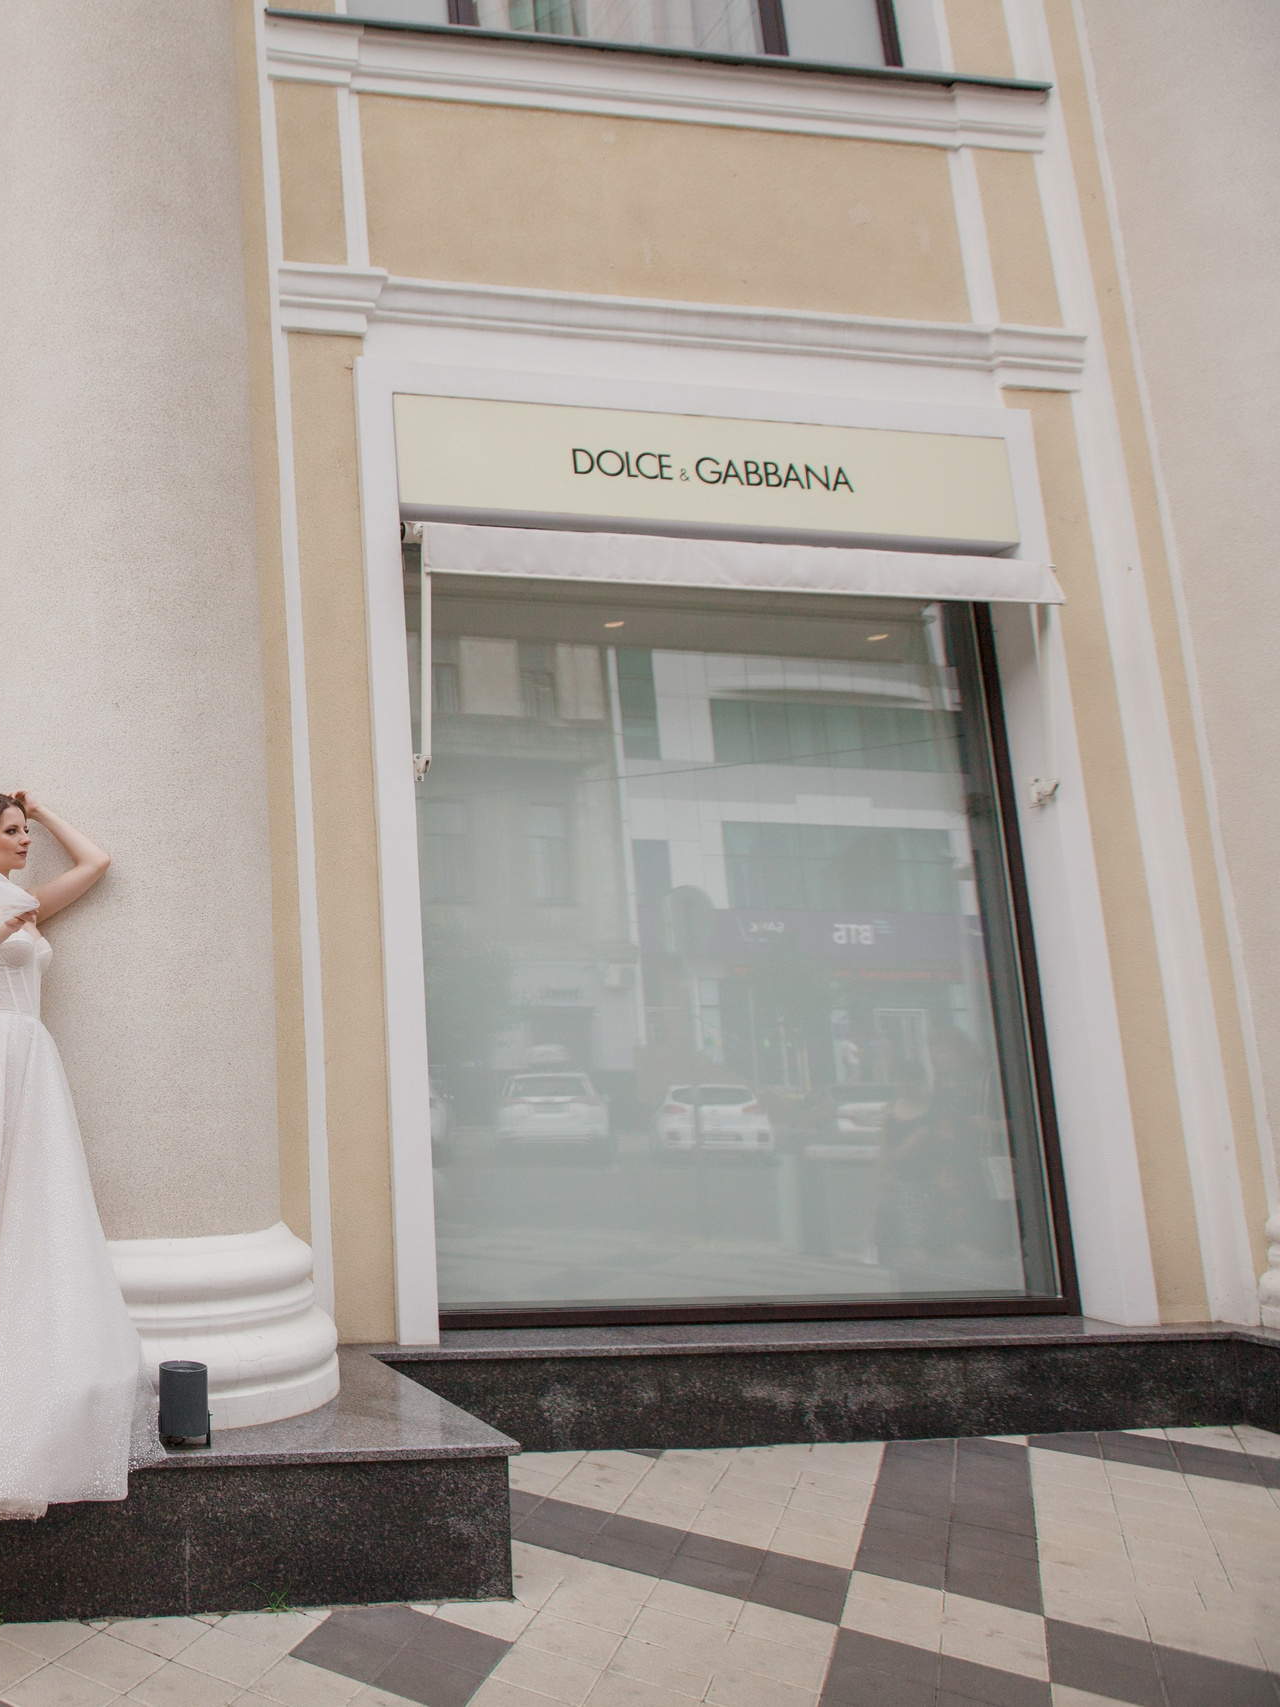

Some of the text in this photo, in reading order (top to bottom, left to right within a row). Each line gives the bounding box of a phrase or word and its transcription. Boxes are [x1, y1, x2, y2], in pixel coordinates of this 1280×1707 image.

[571, 447, 855, 493] DOLCE & GABBANA
